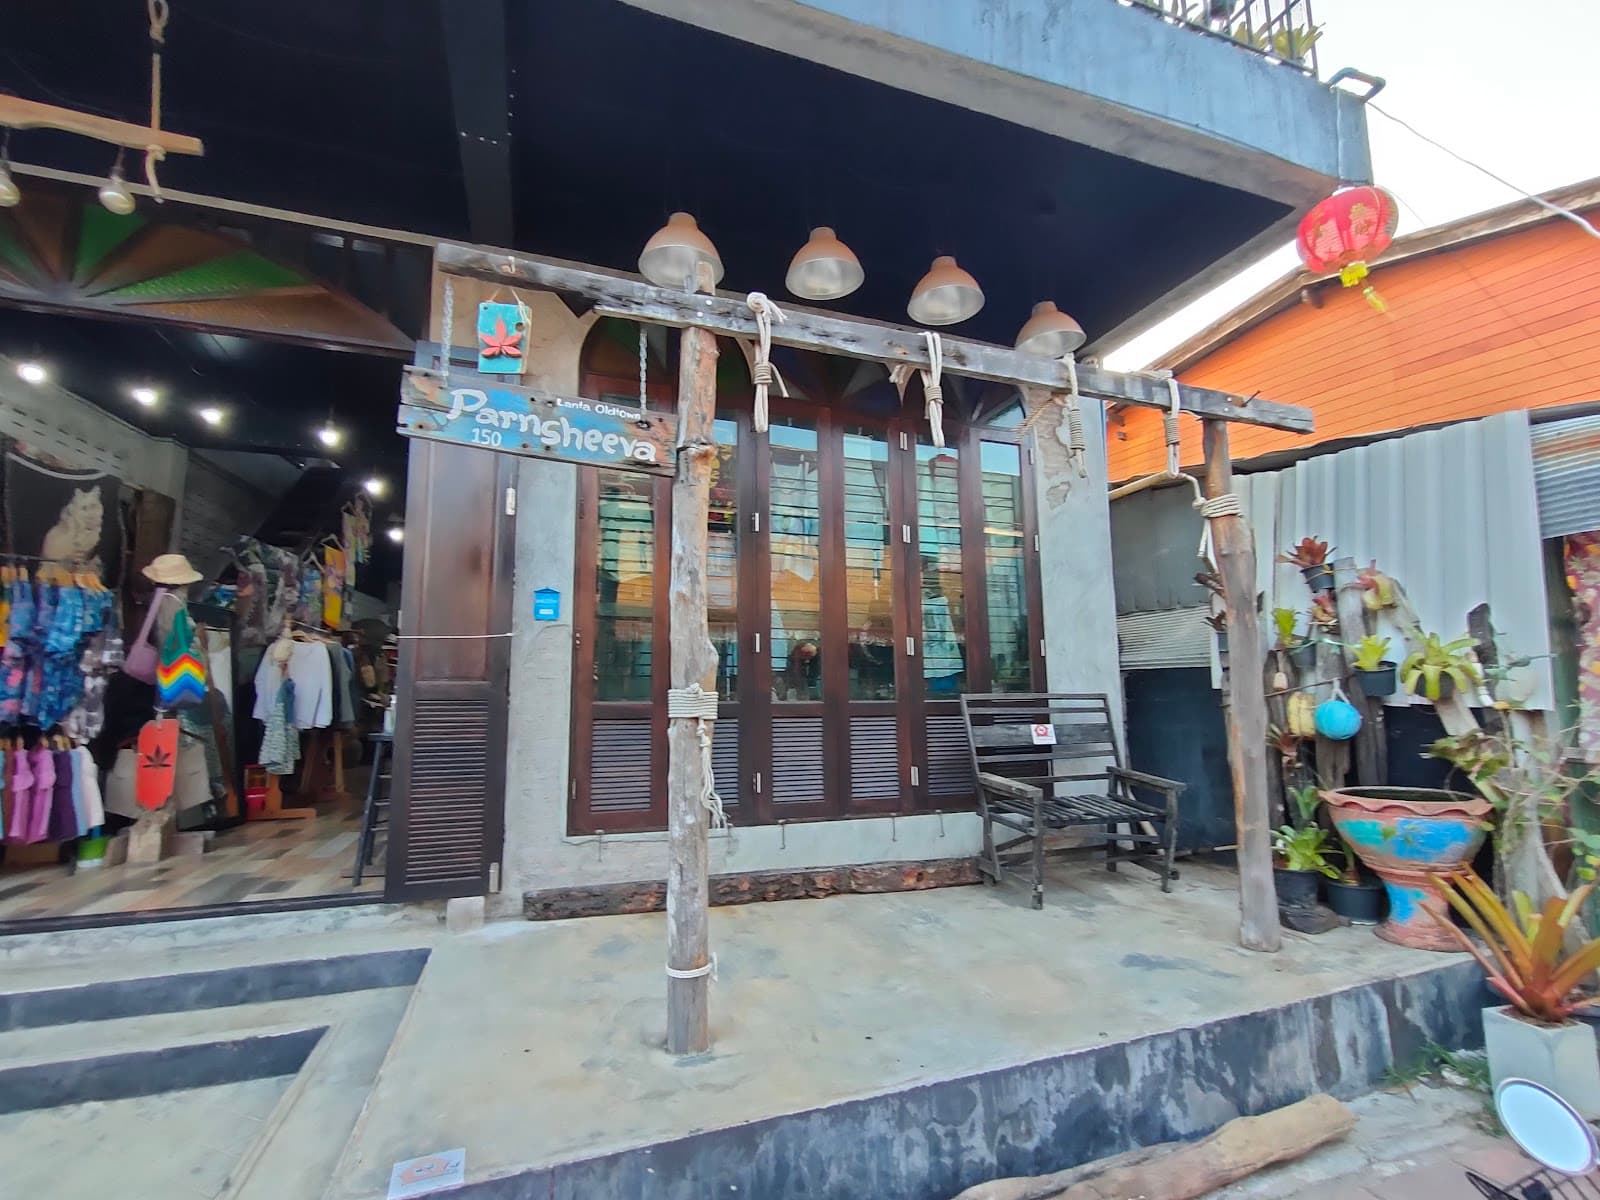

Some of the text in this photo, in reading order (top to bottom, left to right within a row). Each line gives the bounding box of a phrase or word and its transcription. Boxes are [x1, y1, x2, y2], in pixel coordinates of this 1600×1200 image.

[556, 398, 591, 412] Lanta
[446, 388, 656, 462] Parnsheeva
[471, 427, 502, 447] 150
